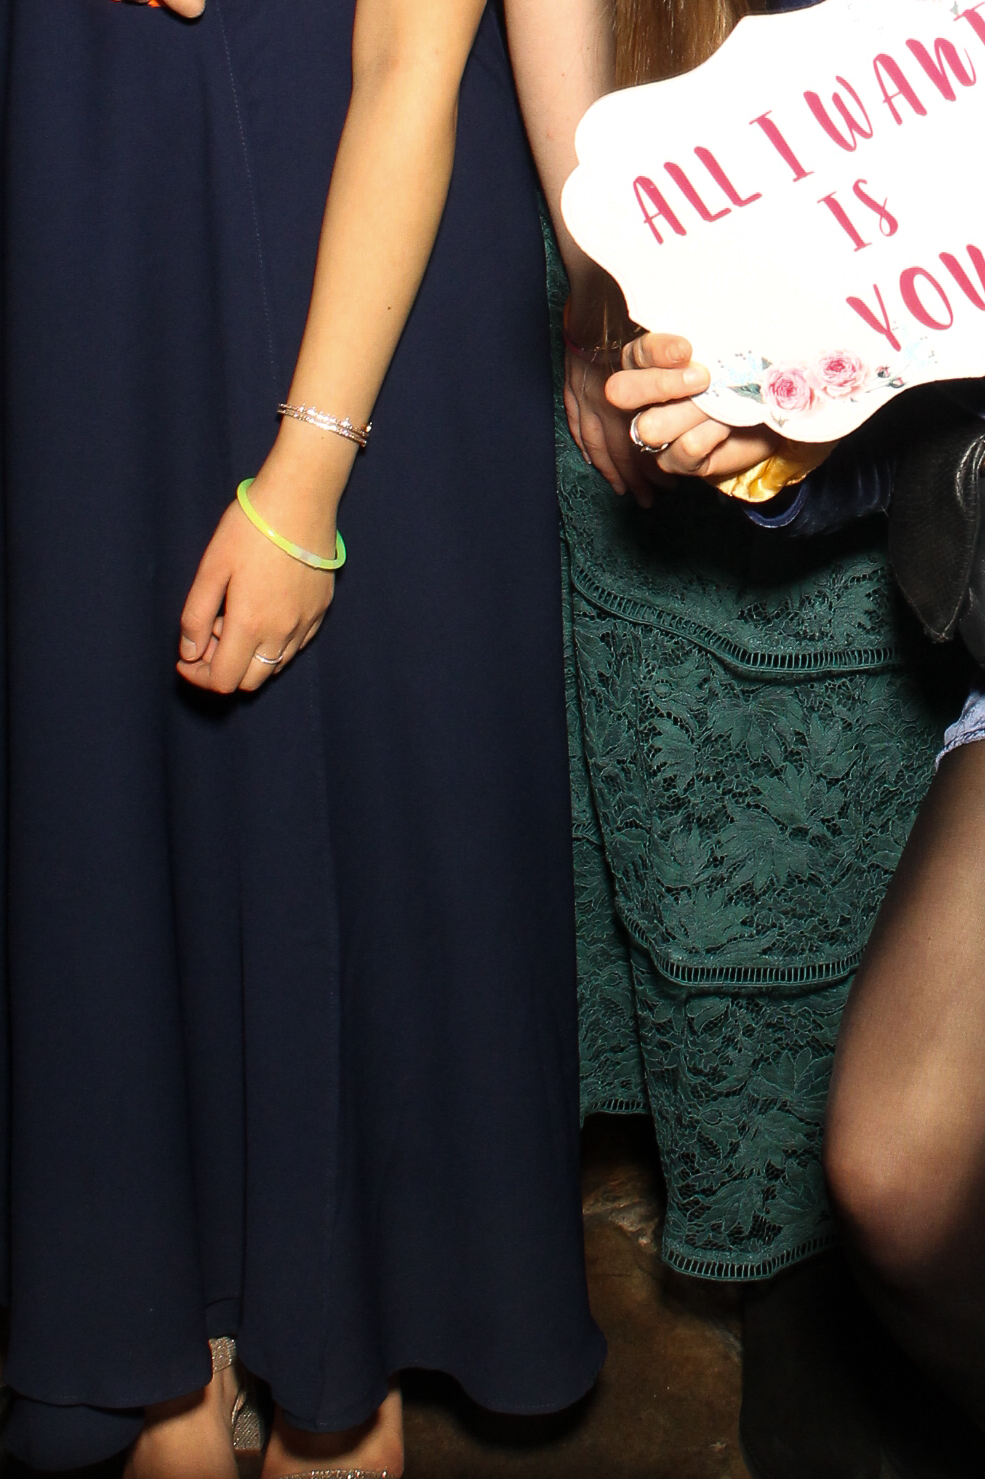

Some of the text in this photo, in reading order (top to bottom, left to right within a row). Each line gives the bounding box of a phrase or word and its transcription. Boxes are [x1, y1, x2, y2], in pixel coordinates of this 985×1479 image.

[632, 145, 762, 245] ALL
[749, 110, 814, 183] I
[817, 178, 899, 252] IS
